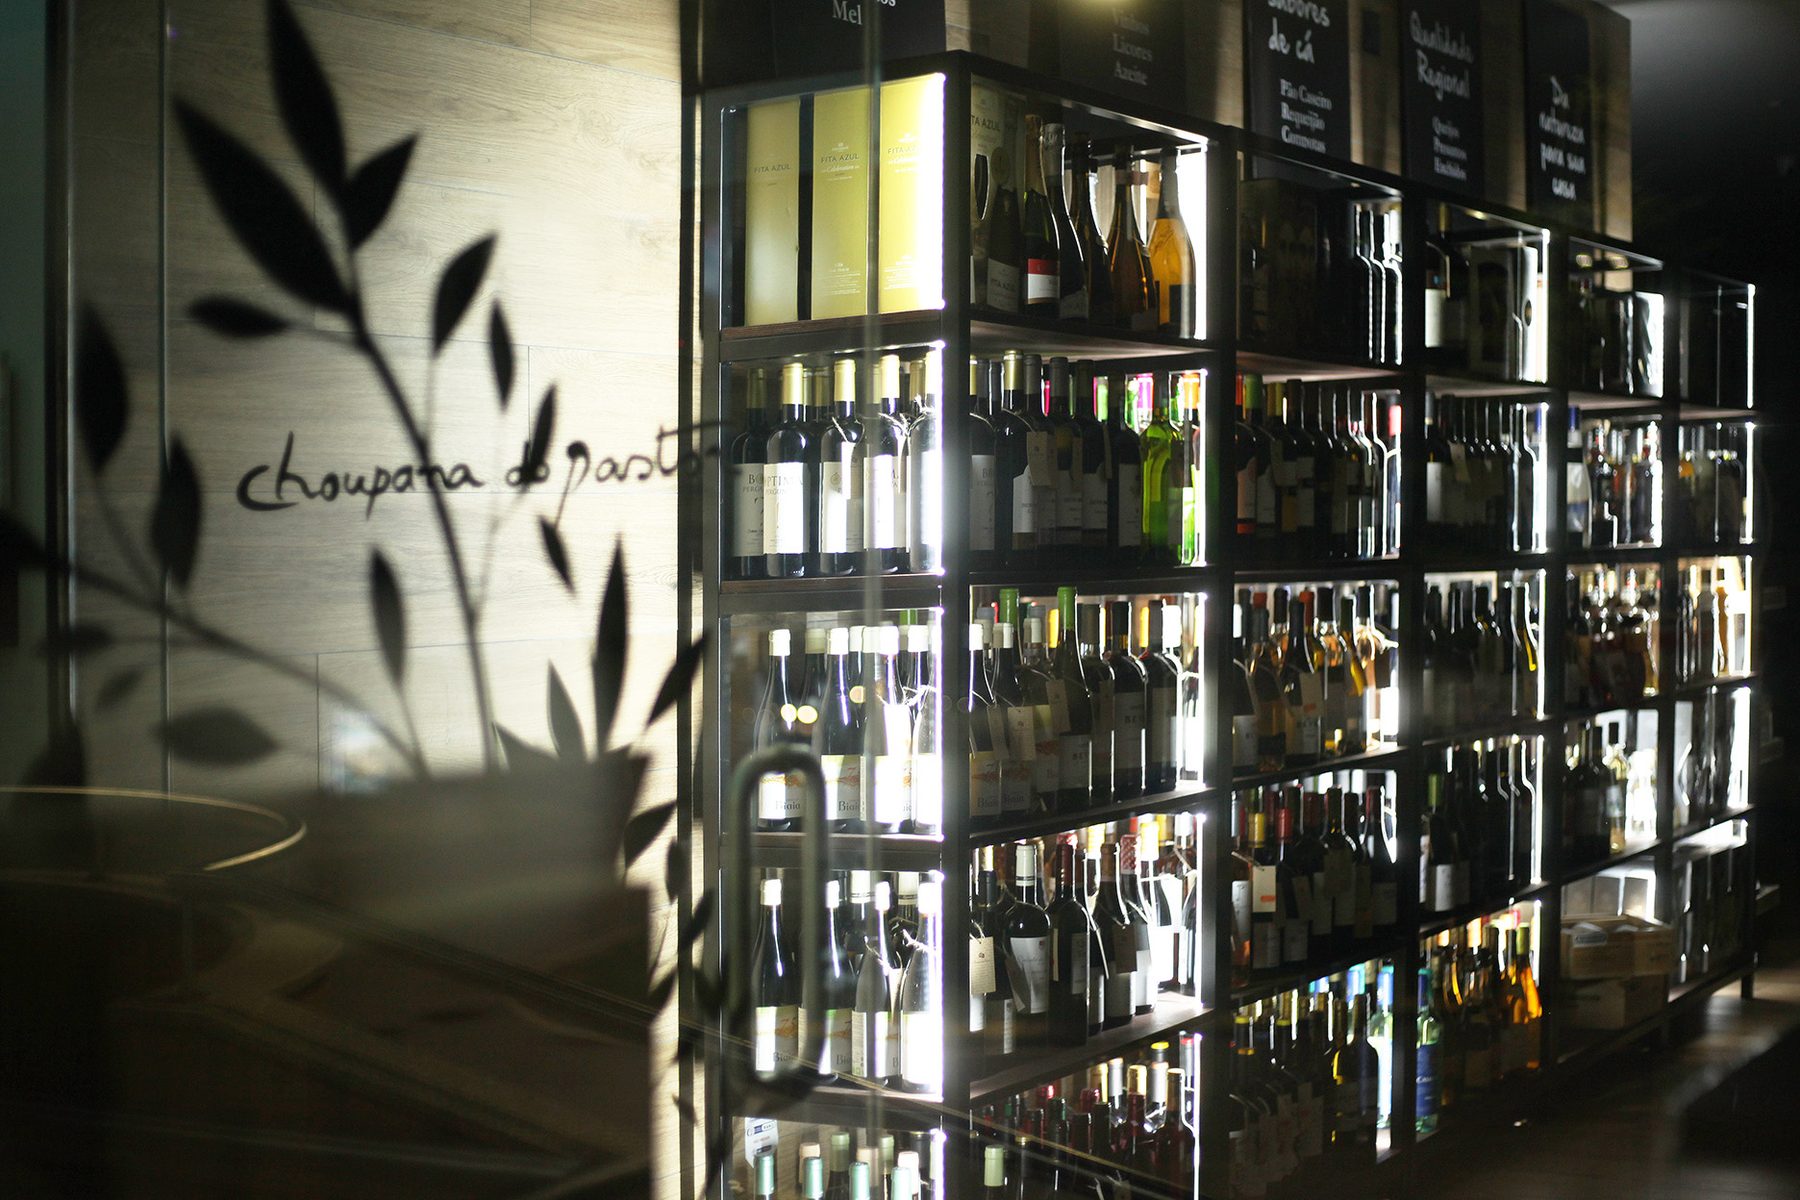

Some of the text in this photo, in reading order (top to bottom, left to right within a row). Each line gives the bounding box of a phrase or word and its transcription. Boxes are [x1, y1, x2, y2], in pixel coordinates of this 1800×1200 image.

[832, 0, 863, 25] Mel
[1268, 16, 1291, 55] de
[1415, 48, 1471, 102] Regional
[839, 152, 859, 161] AZUL
